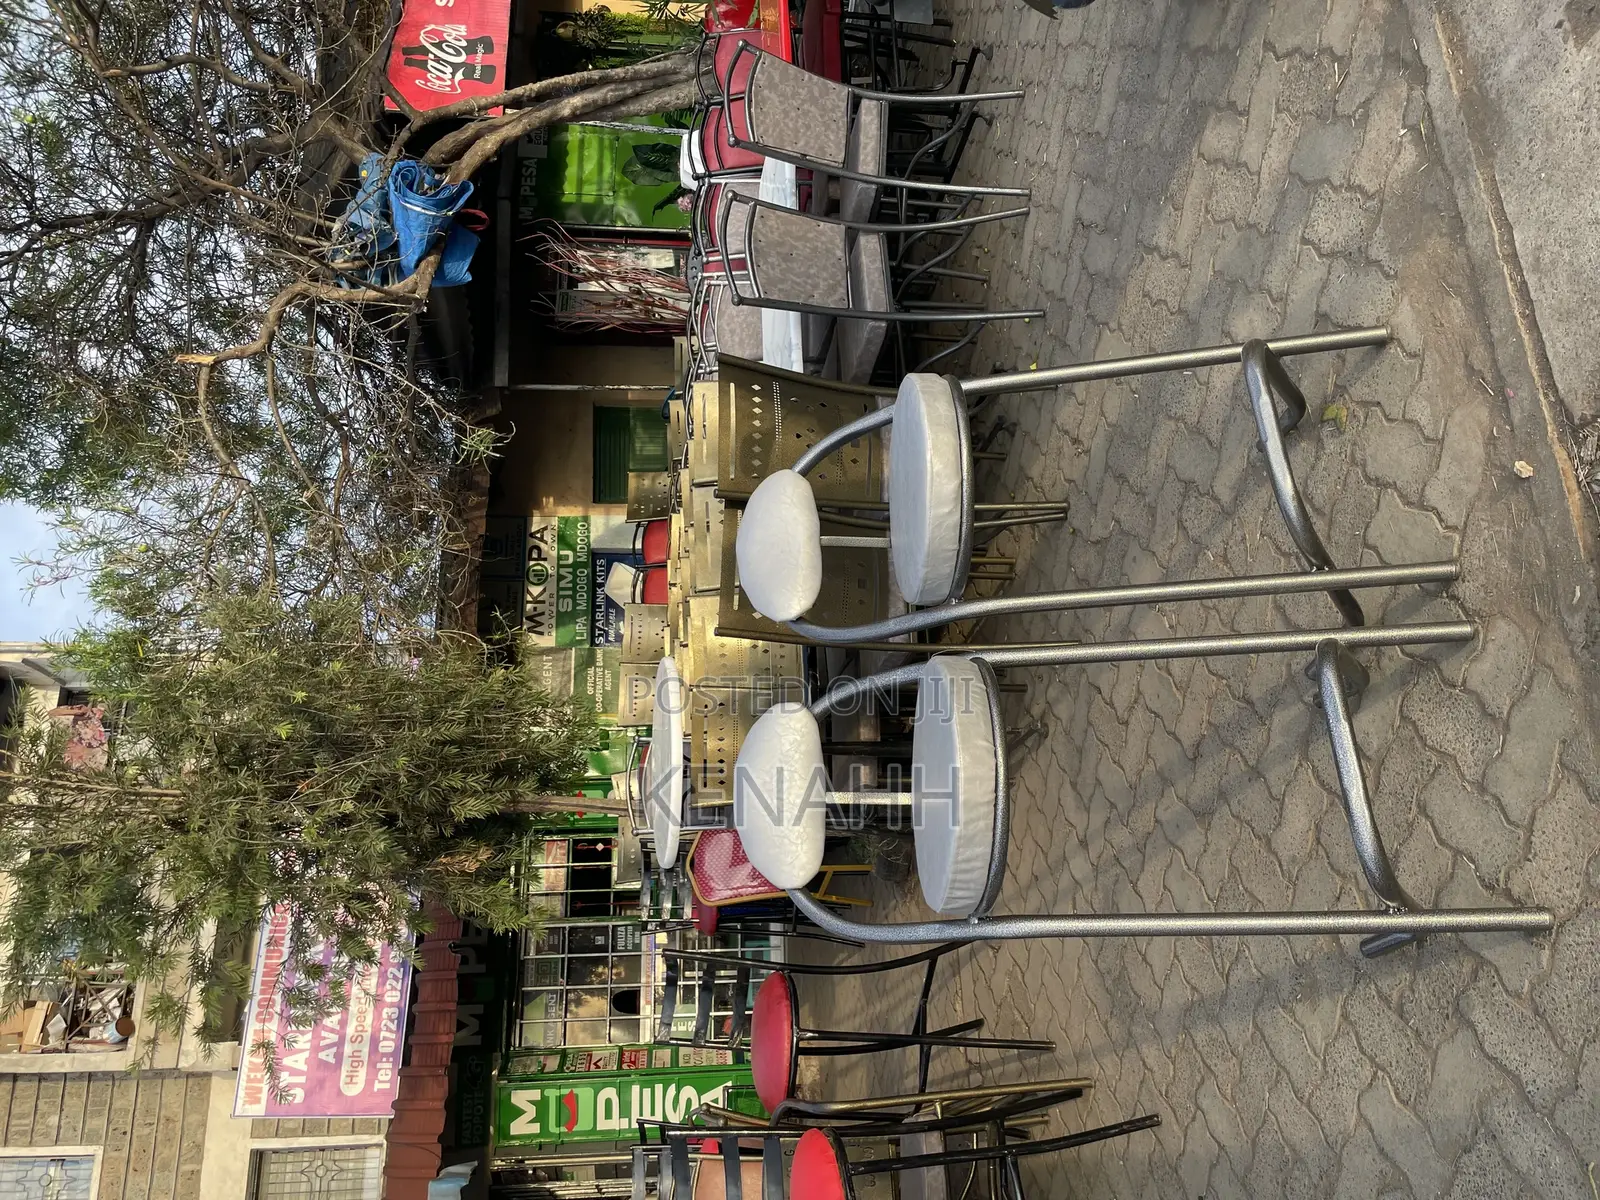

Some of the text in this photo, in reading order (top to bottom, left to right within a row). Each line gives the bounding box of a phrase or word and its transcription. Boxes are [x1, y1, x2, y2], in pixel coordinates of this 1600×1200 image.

[415, 23, 468, 94] Coca-Cola
[474, 42, 484, 78] Real Magic
[525, 524, 549, 636] M-KOPA
[550, 565, 556, 577] TO
[558, 549, 574, 612] SIMU
[576, 521, 588, 639] LIPA MDOGO MDOGO
[596, 586, 604, 644] STARLINK
[608, 607, 616, 642] AVAILABLE
[596, 648, 604, 666] BANK
[604, 669, 612, 690] AGENT
[617, 925, 626, 949] FULIZA
[384, 967, 404, 1002] 022
[350, 996, 368, 1044] Speed
[378, 1006, 399, 1052] 0723
[344, 1049, 363, 1086] High
[374, 1057, 393, 1091] Tel:
